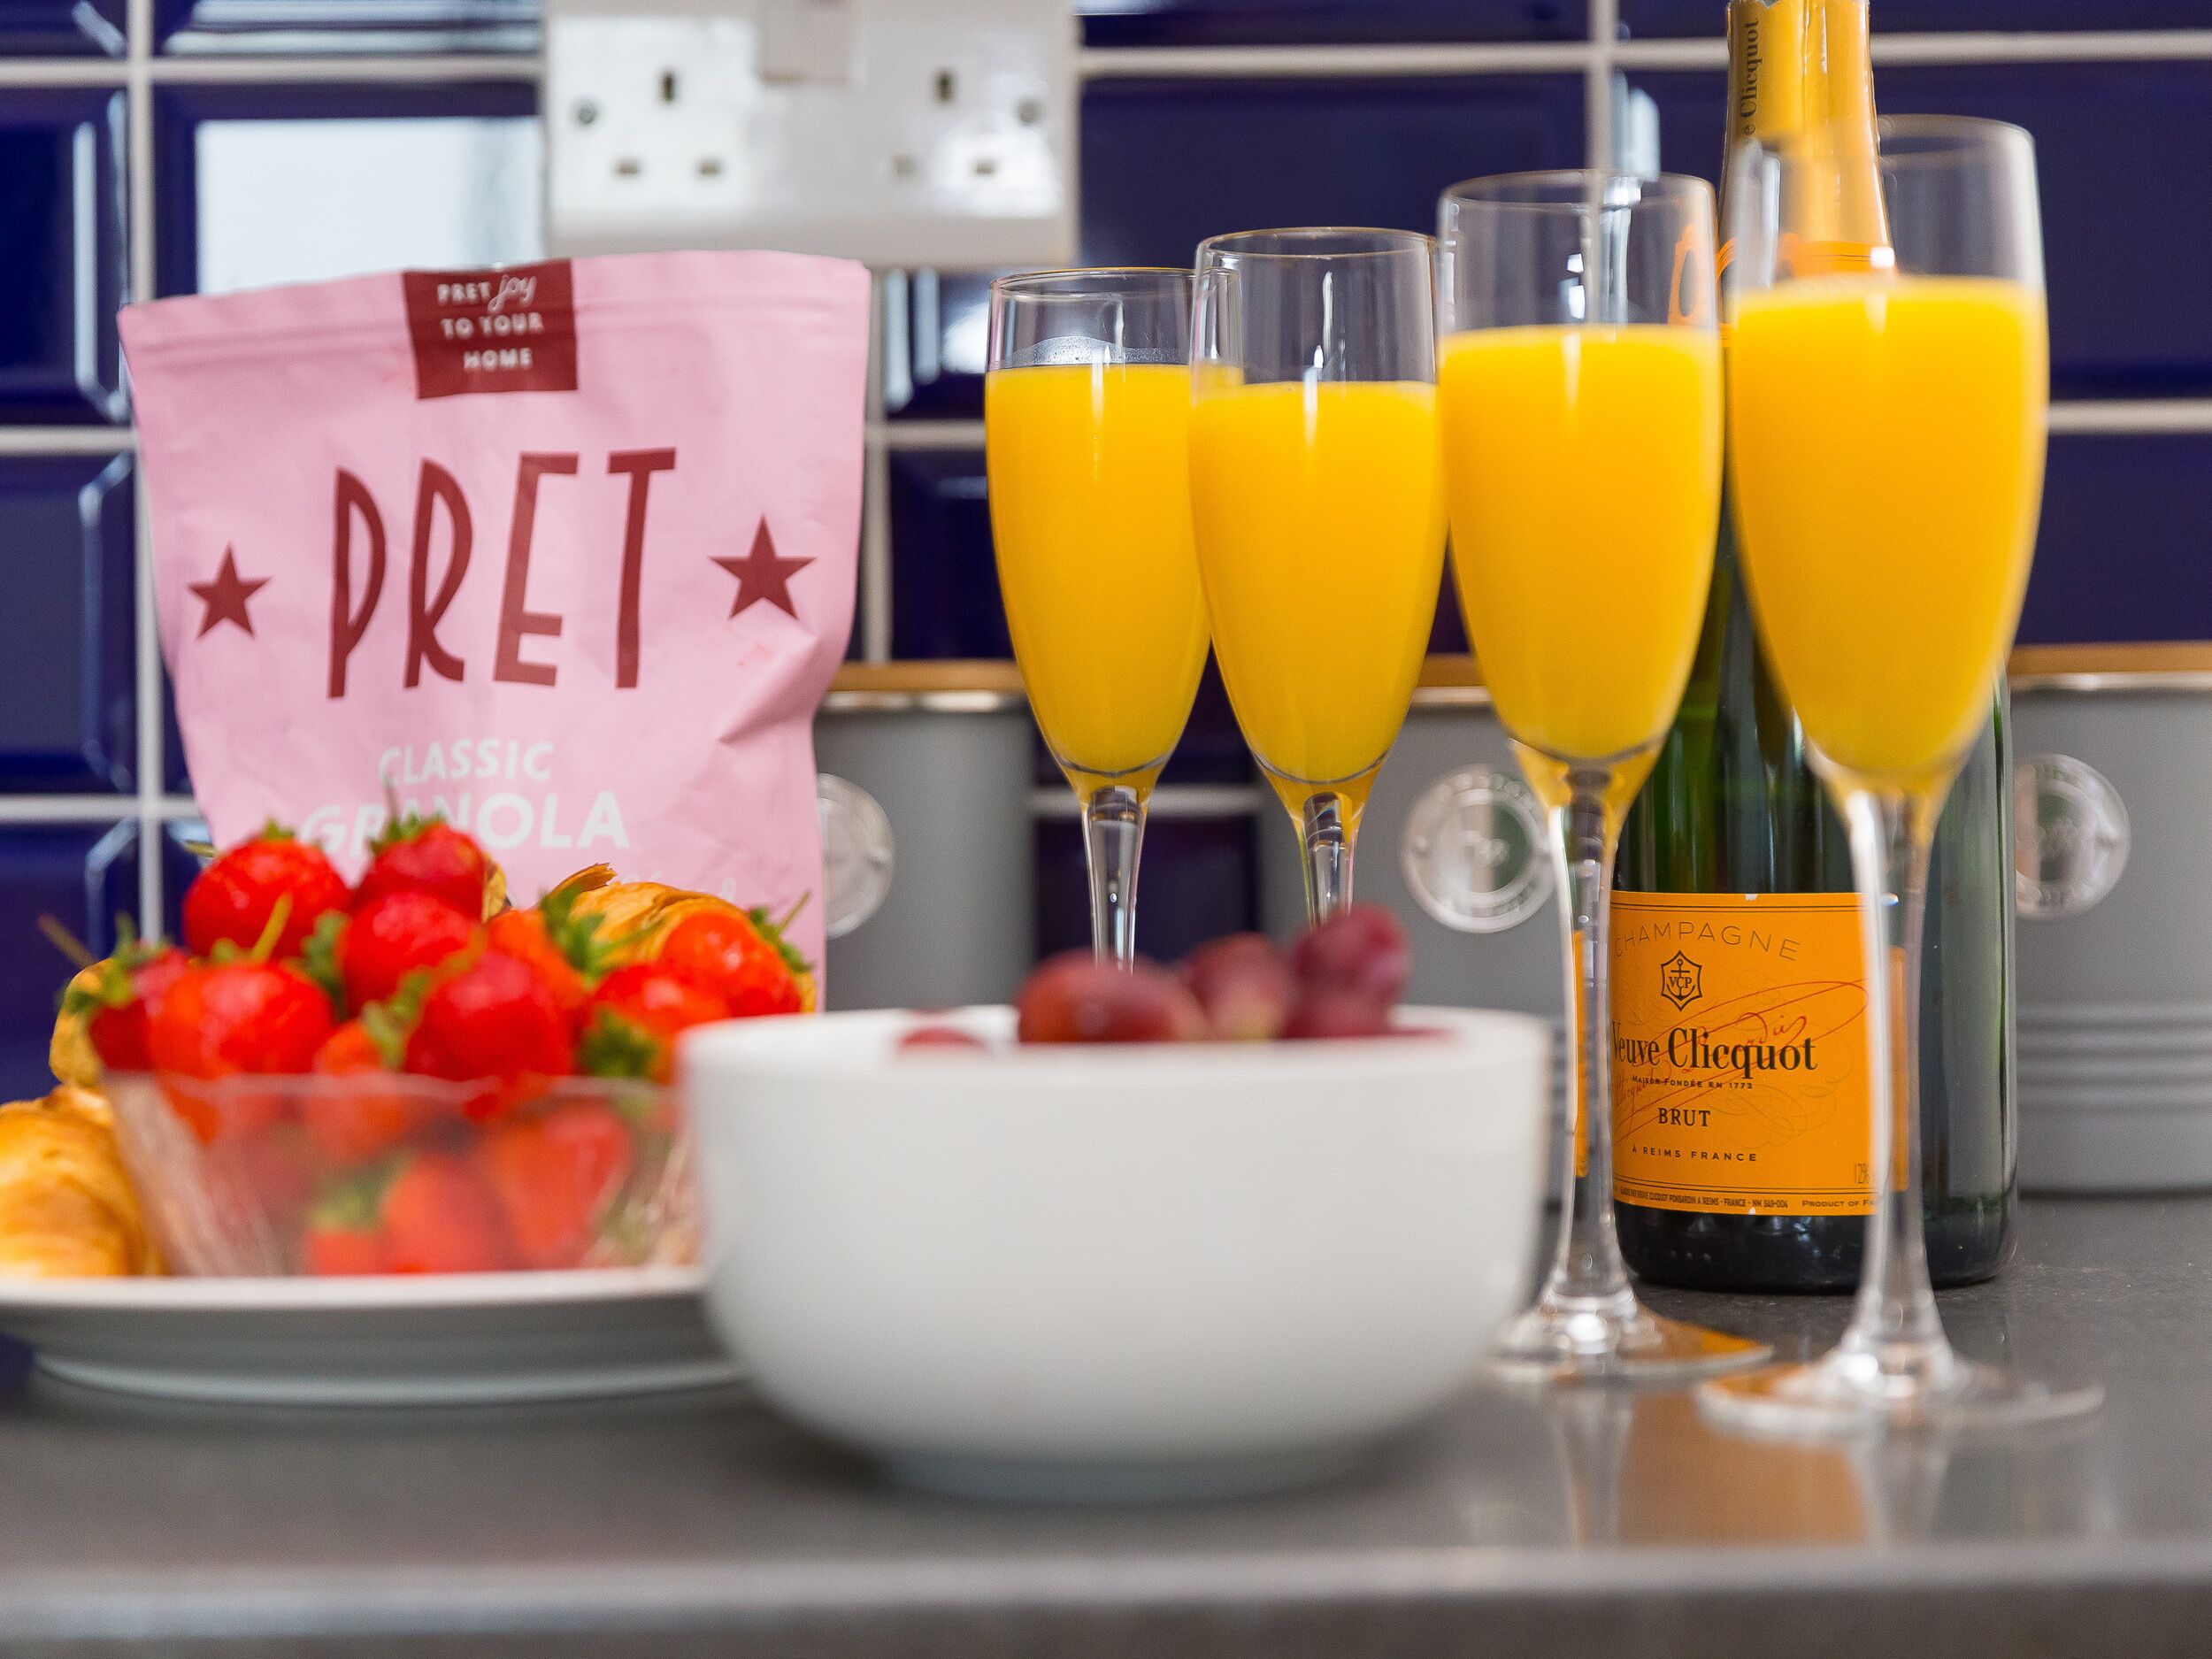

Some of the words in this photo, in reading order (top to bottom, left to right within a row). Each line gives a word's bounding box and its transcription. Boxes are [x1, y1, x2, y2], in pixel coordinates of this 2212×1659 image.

[1740, 19, 1763, 119] Clicquot
[437, 281, 491, 305] PRET
[488, 274, 537, 313] joy
[441, 318, 474, 340] TO
[479, 312, 544, 335] YOUR
[463, 348, 533, 371] HOME
[327, 446, 677, 698] PRET
[378, 738, 554, 787] CLASSIC
[1616, 921, 1801, 962] CHAMPAGNE
[1669, 977, 1693, 990] VCP
[1612, 1021, 1660, 1067] Veuve
[1668, 1027, 1818, 1079] Clicquot
[1658, 1107, 1711, 1127] BRUT
[1643, 1146, 1681, 1158] REIMS
[1691, 1151, 1757, 1162] FRANCE
[1702, 1196, 1719, 1206] REIMS
[1724, 1198, 1747, 1207] FRANCE
